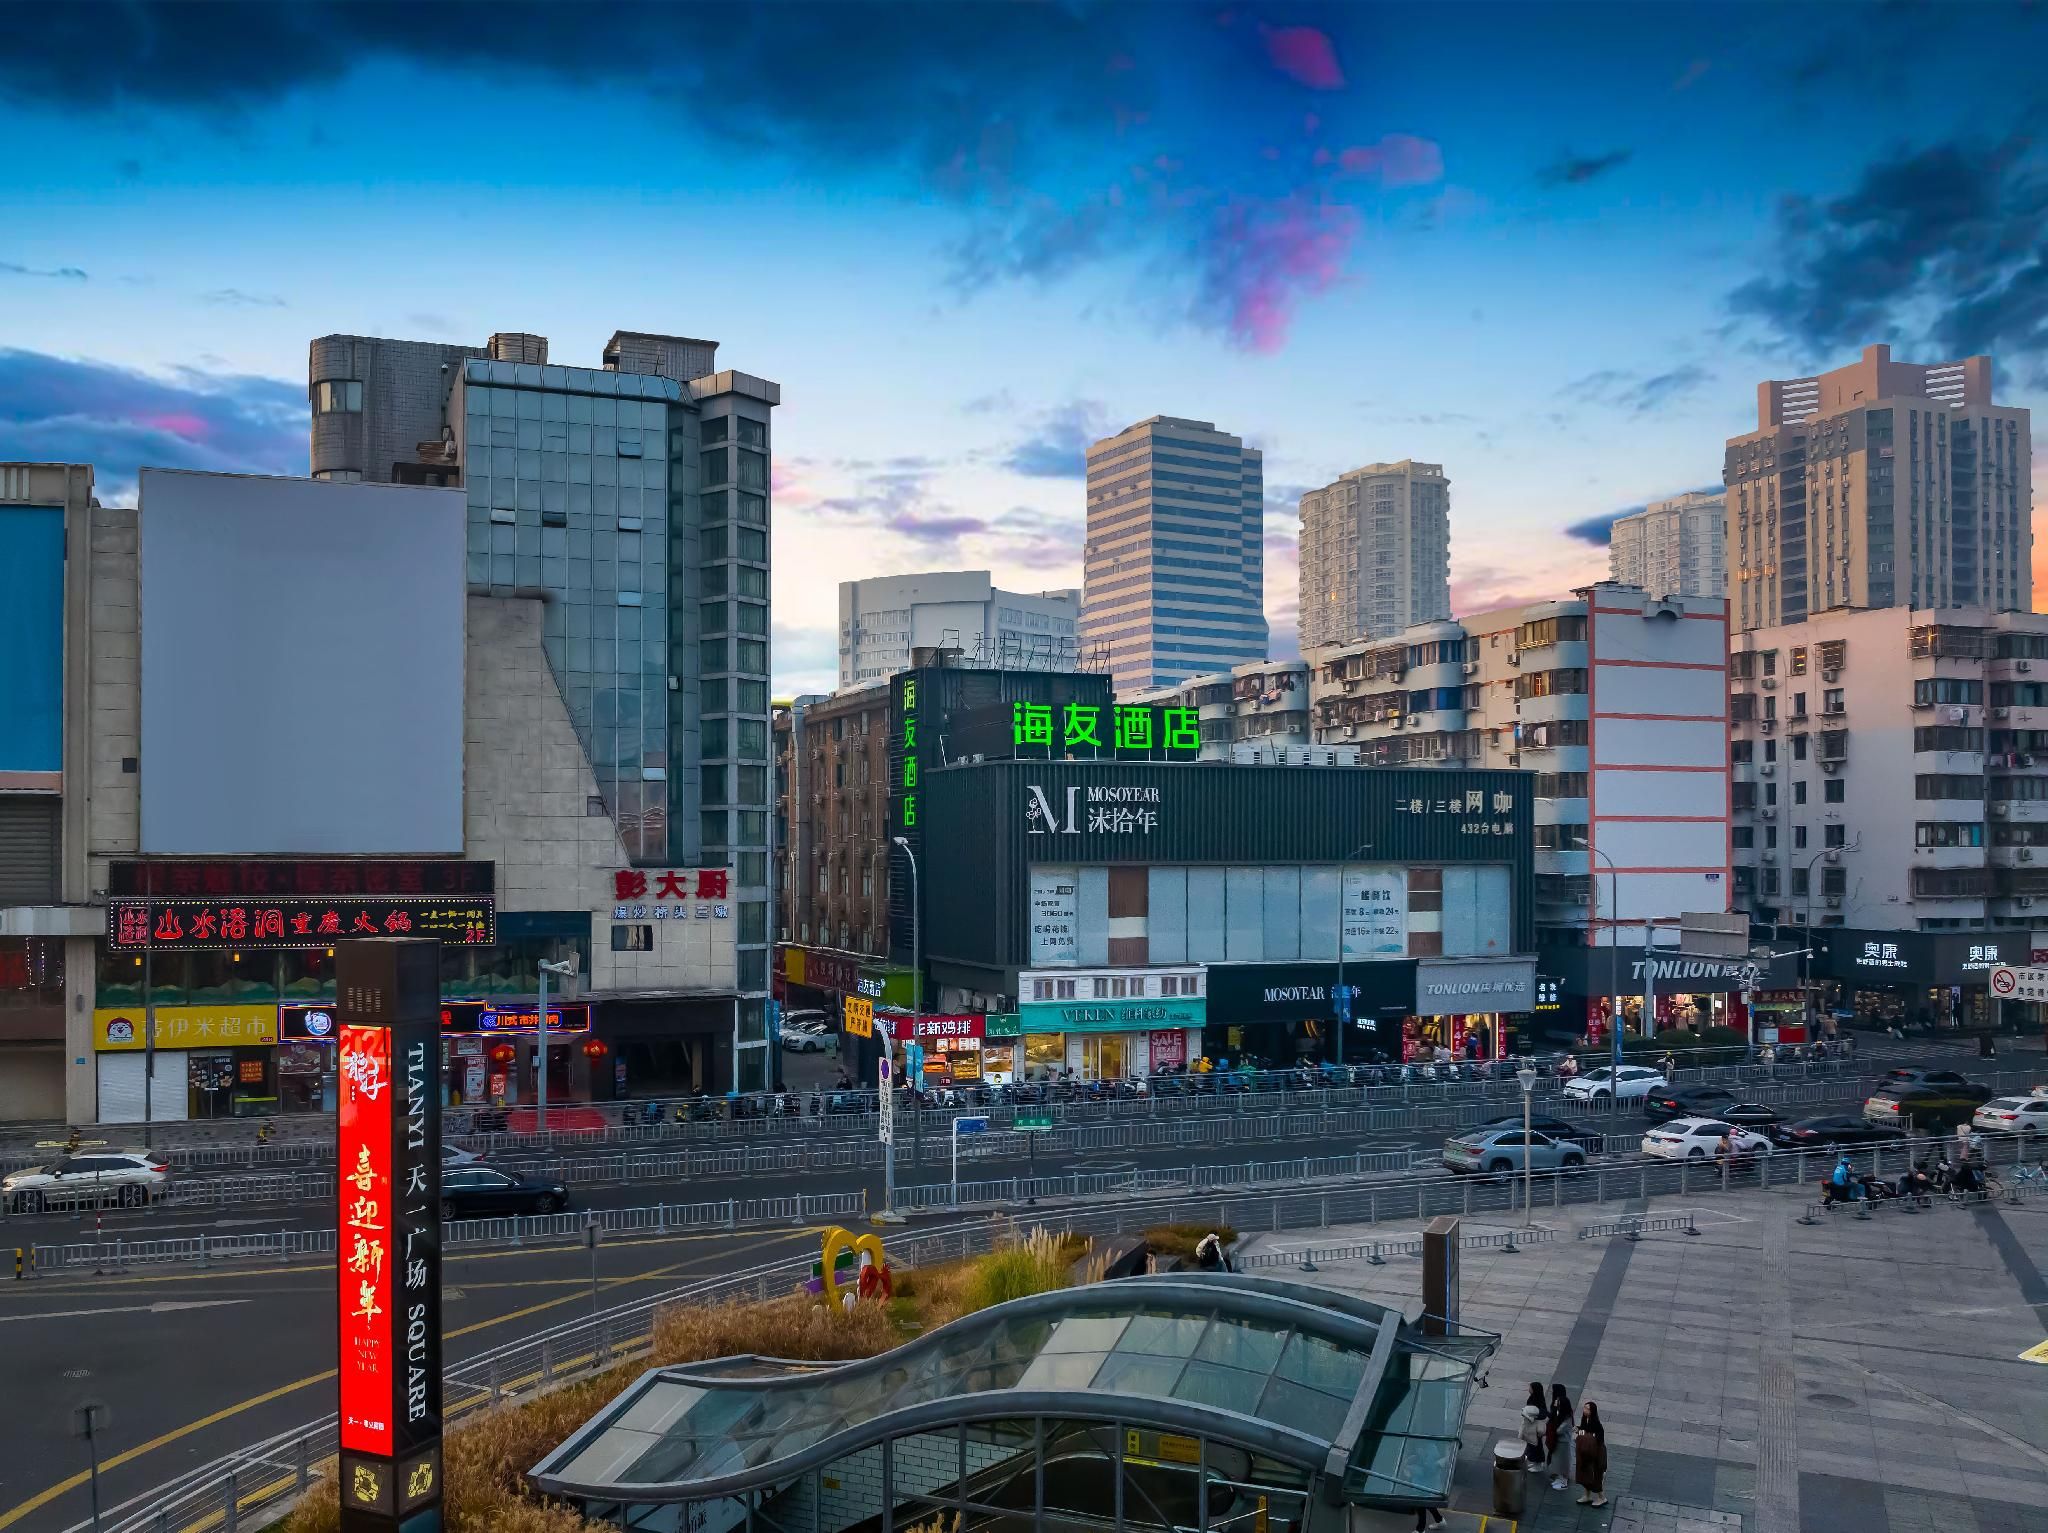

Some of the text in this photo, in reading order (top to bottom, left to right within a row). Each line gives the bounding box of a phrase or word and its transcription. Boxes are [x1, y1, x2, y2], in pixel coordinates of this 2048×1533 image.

[1013, 701, 1200, 749] 海友酒店
[904, 680, 917, 826] 海友酒店
[1087, 786, 1161, 803] MOSOYEAR
[615, 870, 729, 900] 彭大厨
[466, 929, 486, 942] 2F
[1864, 942, 1898, 959] 奥康
[1969, 945, 1998, 961] 奥康
[1264, 986, 1325, 1001] MOSOYEAR
[1426, 983, 1479, 995] TONLION
[2018, 987, 2048, 997] 自觉遵
[1062, 1008, 1115, 1022] VEKEN
[913, 1020, 971, 1035] 正新鸡排
[1151, 1032, 1182, 1046] SALE
[408, 1042, 425, 1150] TIANYI
[346, 1143, 385, 1324] 喜迎新年
[405, 1163, 427, 1291] 天一广场
[353, 1335, 380, 1348] HAPPY
[358, 1349, 377, 1360] NEW
[357, 1360, 379, 1373] YEAR
[408, 1303, 426, 1423] SQUARE
